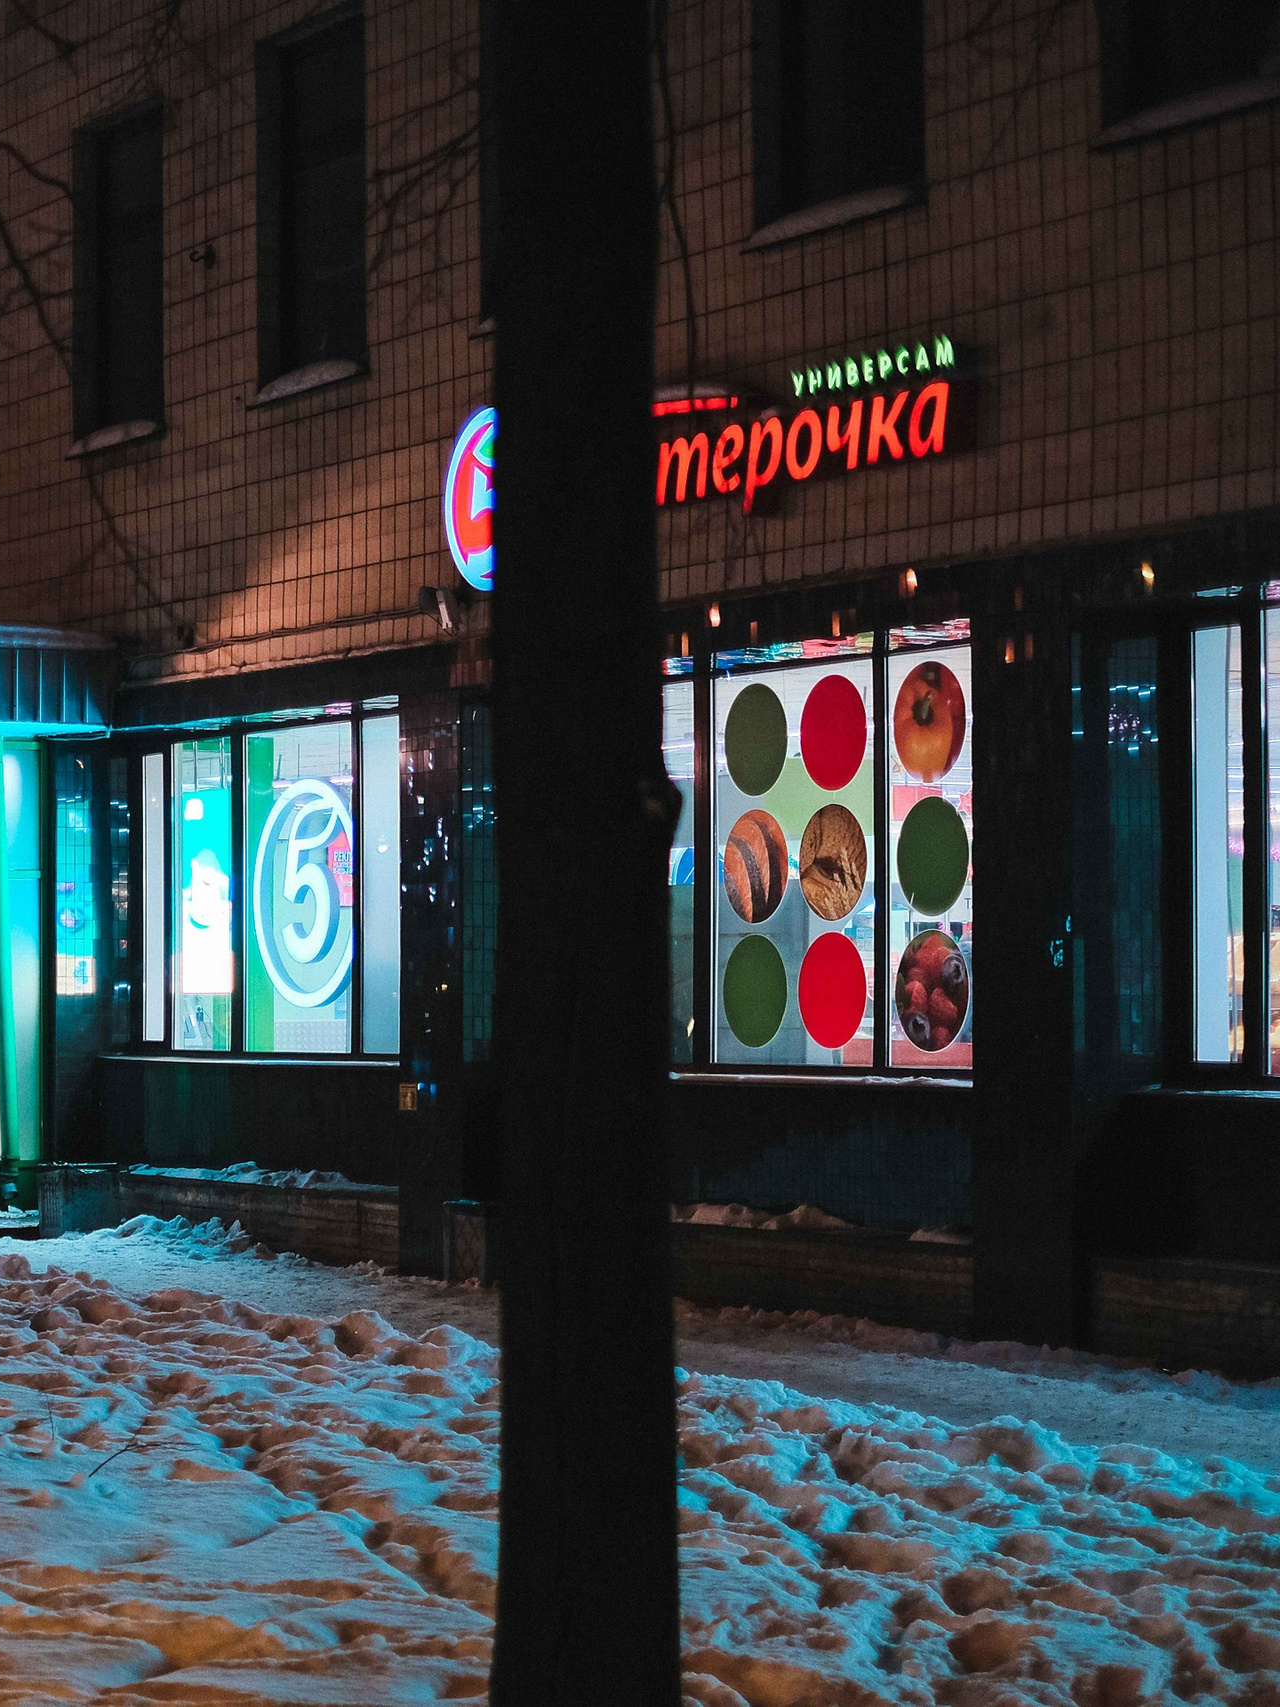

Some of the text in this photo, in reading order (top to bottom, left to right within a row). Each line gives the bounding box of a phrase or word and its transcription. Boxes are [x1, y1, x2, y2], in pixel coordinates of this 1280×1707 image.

[791, 335, 955, 398] УНИВЕРСАМ
[653, 380, 950, 514] терочка
[281, 796, 339, 965] 5
